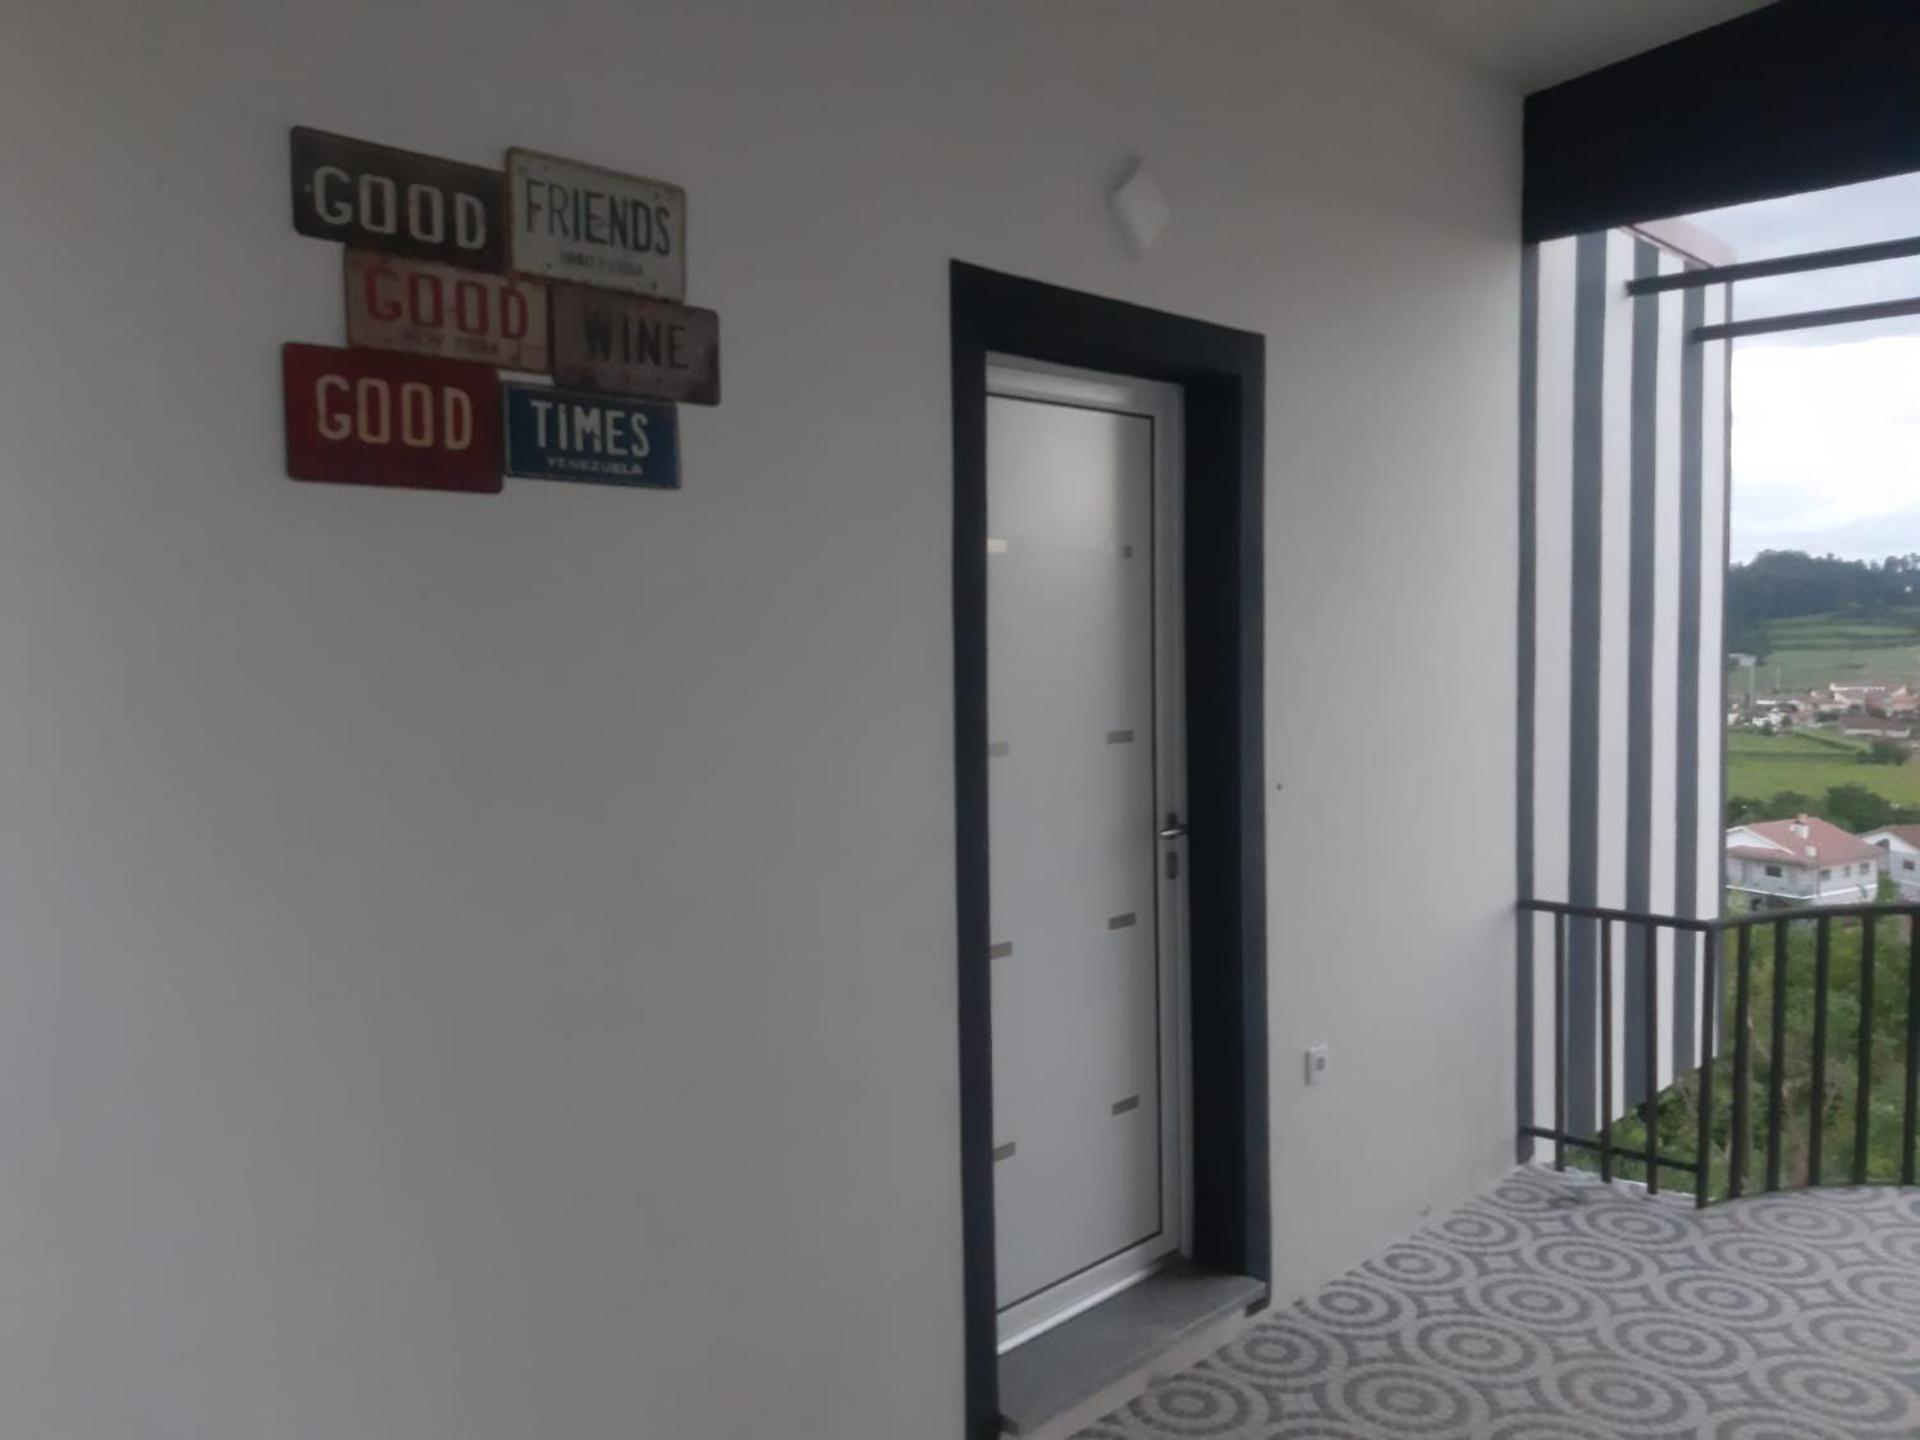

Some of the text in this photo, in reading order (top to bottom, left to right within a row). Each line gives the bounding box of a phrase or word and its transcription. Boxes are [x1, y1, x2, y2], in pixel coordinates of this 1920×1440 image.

[313, 166, 487, 250] GOOD
[526, 178, 672, 257] FRIENDS
[363, 262, 530, 341] GOOD
[584, 308, 689, 371] WINE
[315, 374, 473, 450] GOOD
[530, 399, 651, 458] TIMES
